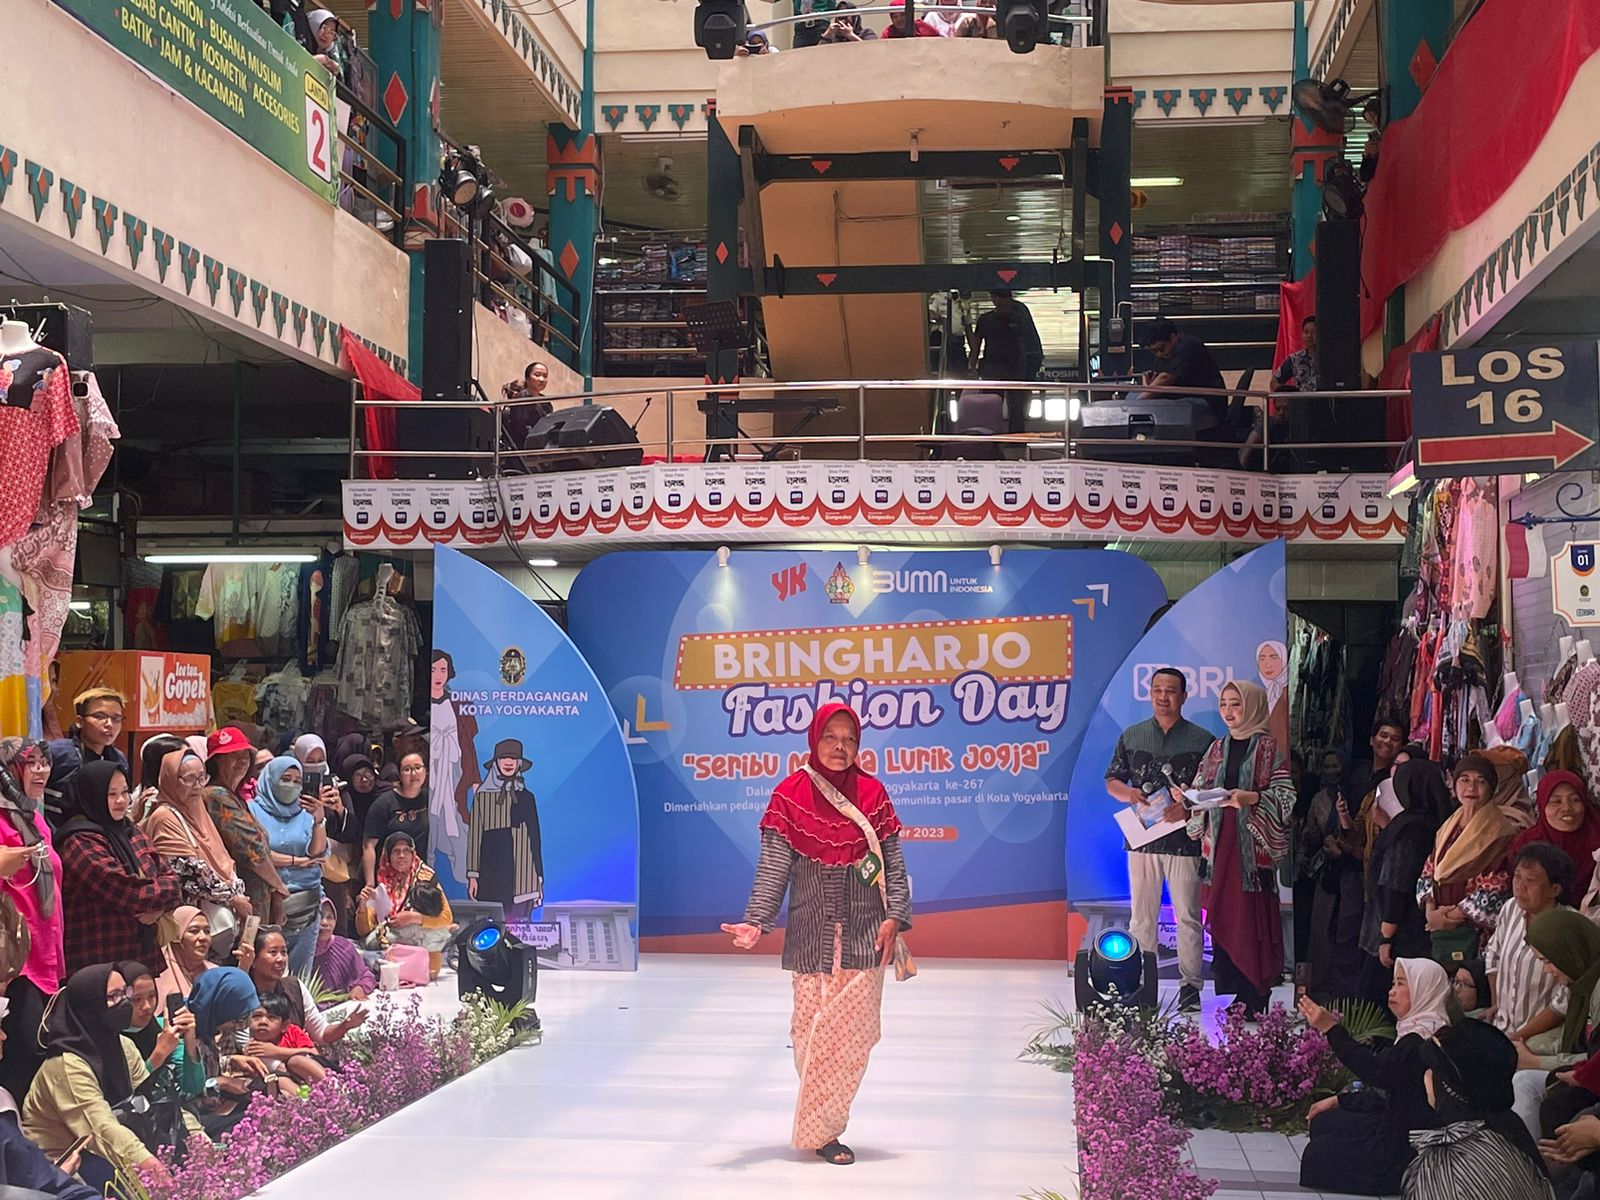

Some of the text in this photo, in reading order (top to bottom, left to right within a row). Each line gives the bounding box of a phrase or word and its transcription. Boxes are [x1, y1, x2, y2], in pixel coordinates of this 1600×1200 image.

[121, 6, 245, 118] BATIK JAM & KACAMATA
[159, 5, 195, 51] CANTIK
[202, 40, 247, 92] KOSMETIK
[253, 82, 299, 135] ACCESORIES
[210, 18, 247, 66] BUSANA
[248, 51, 281, 93] MUSLIM
[312, 109, 325, 172] 2
[1441, 347, 1565, 386] LOS
[1466, 388, 1543, 425] 16
[1577, 555, 1588, 566] 01
[771, 562, 807, 601] YK
[873, 570, 947, 593] BUMN
[950, 585, 993, 593] INDONESIA
[714, 631, 1031, 679] BRINGHARJO
[165, 672, 206, 705] Gopek
[450, 691, 588, 702] DINAS PERDAGANGAN
[724, 670, 1071, 736] Fashion Day
[459, 704, 580, 716] KOTA YOGYAKARTA
[664, 801, 728, 813] Dimeriahkan
[730, 800, 767, 813] pedaga
[944, 795, 973, 807] pasar
[975, 793, 985, 804] di
[987, 792, 1010, 803] Kota
[1012, 791, 1069, 804] Yogyakarta
[746, 779, 984, 797] Dala ogyakarta ke-267
[913, 827, 945, 838] 2023
[861, 859, 876, 880] 65
